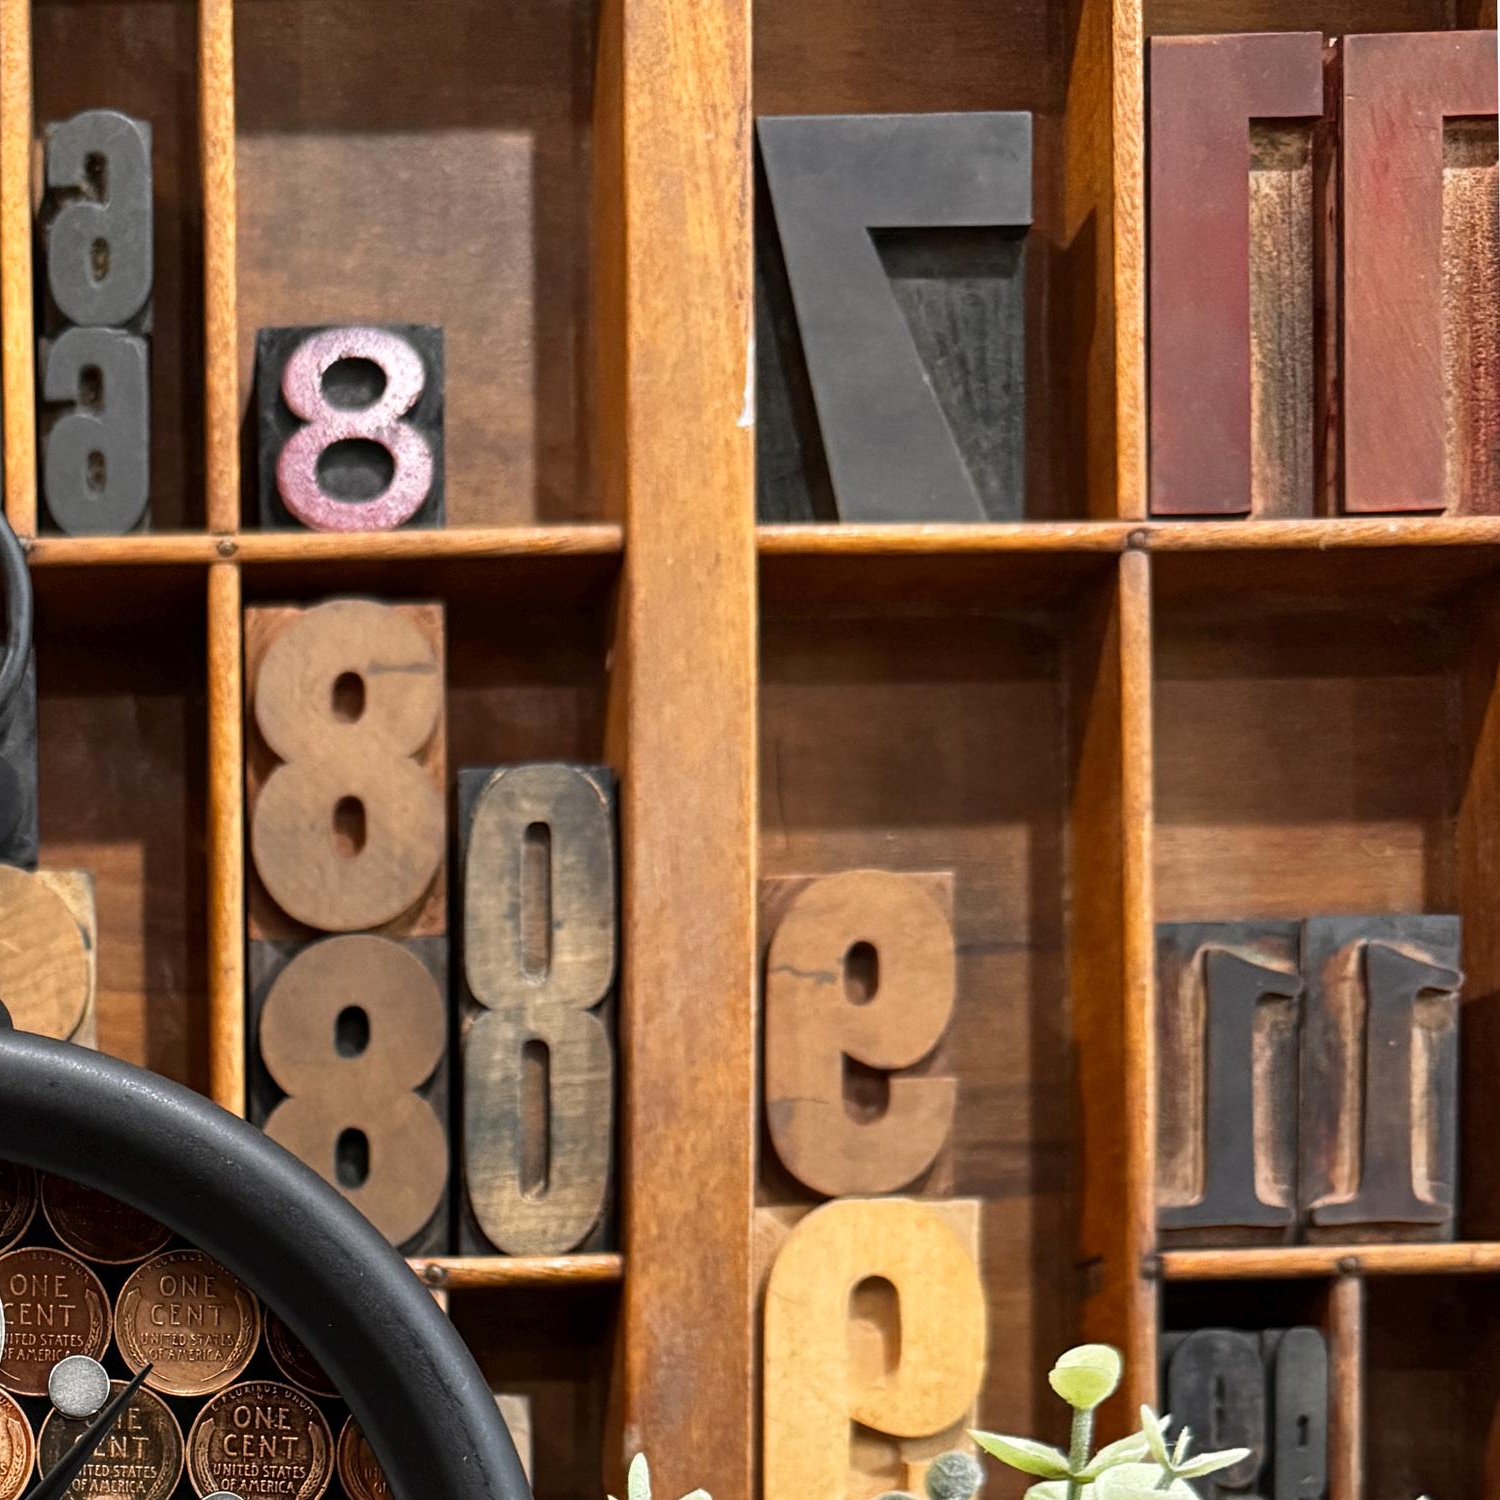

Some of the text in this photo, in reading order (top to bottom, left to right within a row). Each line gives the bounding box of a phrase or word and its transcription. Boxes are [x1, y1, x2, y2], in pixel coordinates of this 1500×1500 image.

[276, 326, 433, 533] 8
[253, 598, 442, 932] 8
[464, 761, 615, 1256] 8
[259, 934, 449, 1250] 8
[9, 1274, 68, 1298] ONE
[158, 1274, 217, 1298] ONE
[149, 1303, 225, 1327] CENT
[232, 1405, 291, 1429] ONE
[223, 1434, 299, 1458] CENT
[213, 1463, 307, 1477] UNITED STATES
